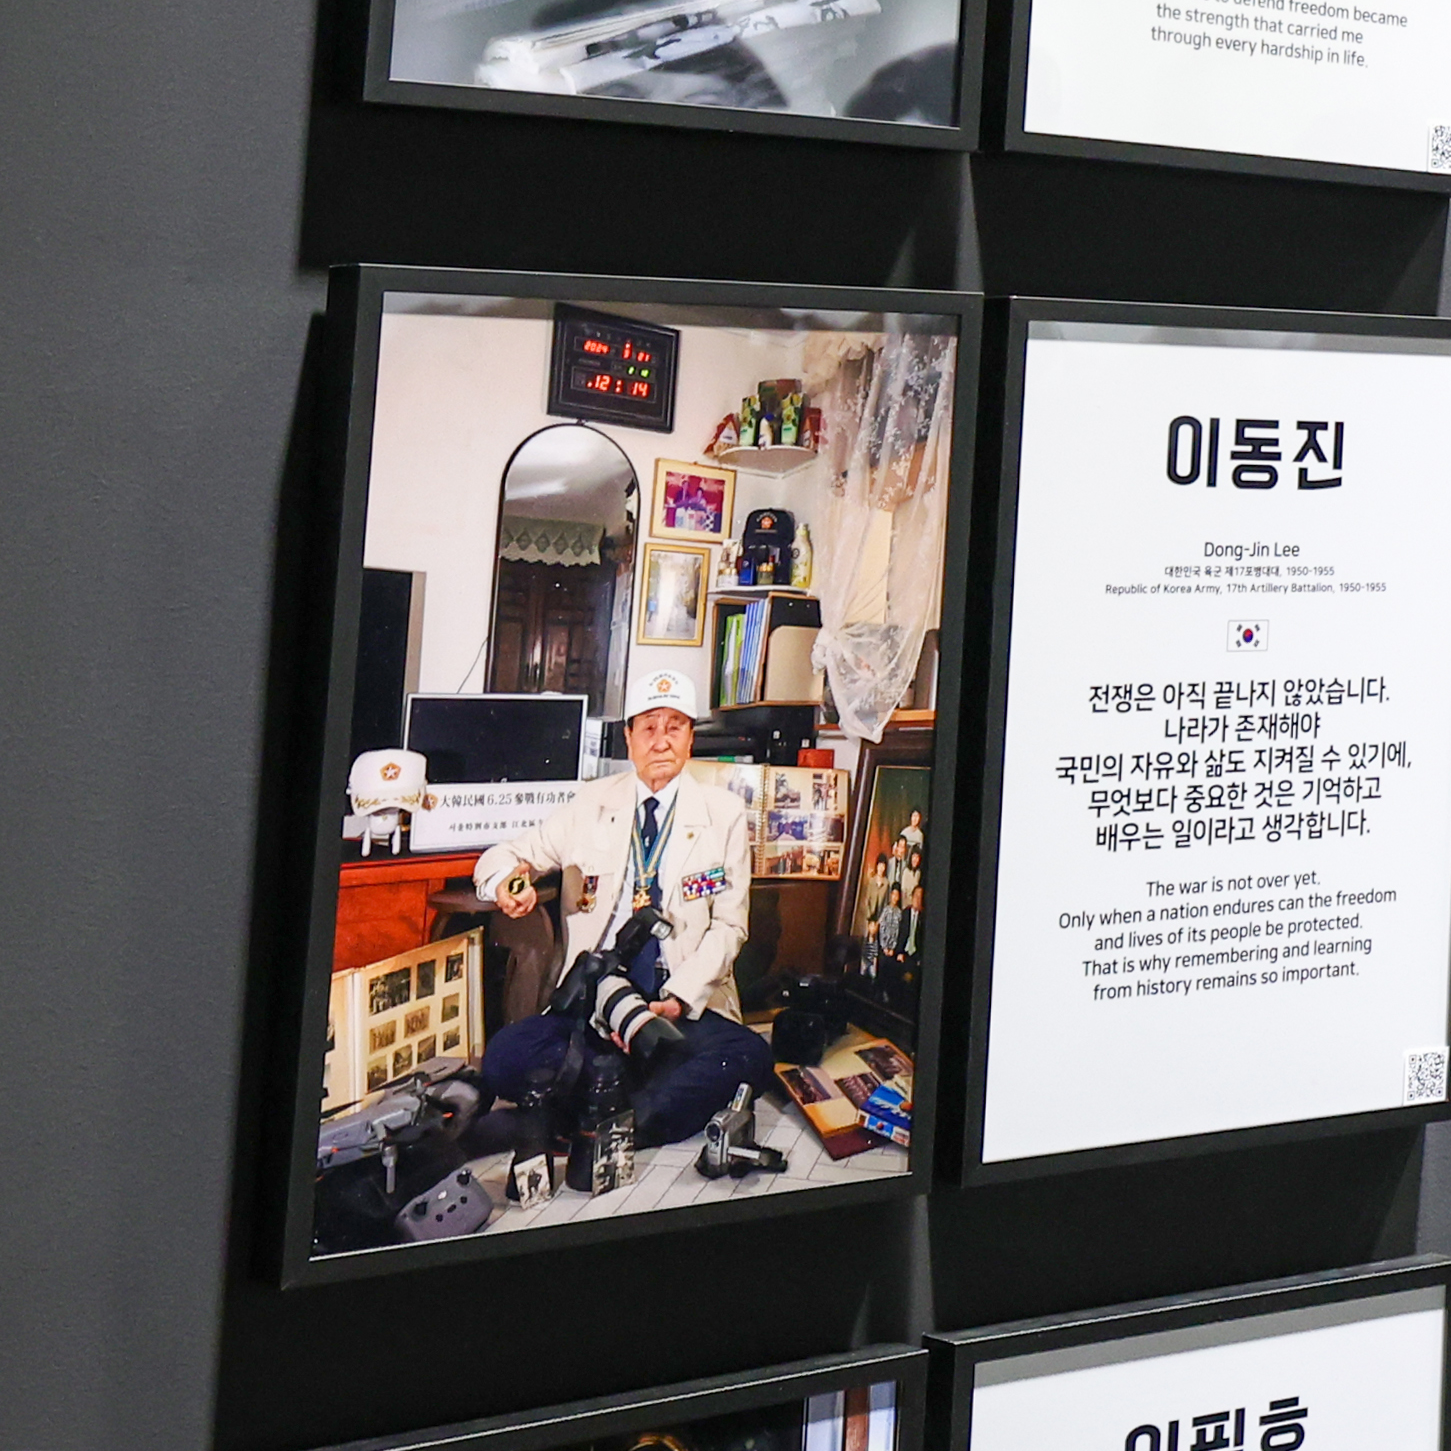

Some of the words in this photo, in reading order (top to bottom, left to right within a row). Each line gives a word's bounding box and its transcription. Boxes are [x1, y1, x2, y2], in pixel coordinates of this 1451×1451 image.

[1165, 414, 1345, 491] 이동진
[1203, 540, 1270, 562] Dong-Jin
[1273, 541, 1300, 558] Lee
[1164, 565, 1202, 578] 대한민국
[1285, 565, 1336, 577] 1950-1955
[1088, 682, 1156, 714] 전쟁은
[1162, 680, 1206, 711] 아직
[1212, 678, 1276, 710] 끝나지
[1282, 675, 1390, 707] 않았습니다.
[1164, 714, 1229, 745] 나라가
[1234, 711, 1321, 742] 존재해야
[1055, 753, 1123, 785] 국민의
[1129, 749, 1199, 781] 자유와
[1203, 748, 1247, 778] 삶도
[1252, 744, 1314, 775] 지켜질
[1320, 744, 1341, 772] 수
[1347, 740, 1411, 770] 있기에,
[1087, 785, 1178, 818] 무엇보다
[1183, 781, 1248, 814] 중요한
[1253, 779, 1295, 809] 것은
[1302, 775, 1382, 806] 기억하고
[1095, 821, 1165, 852] 배우는
[1171, 816, 1256, 849] 일이라고
[1261, 808, 1370, 843] 생각합니다.
[1145, 880, 1175, 897] The
[1178, 880, 1208, 895] war
[1211, 875, 1224, 893] is
[1227, 874, 1253, 891] not
[1256, 874, 1290, 889] over
[1293, 870, 1320, 890] yet.
[1058, 910, 1096, 931] Only
[1098, 908, 1142, 926] when
[1145, 908, 1156, 922] a
[1159, 902, 1209, 921] nation
[1212, 898, 1275, 917] endures
[1277, 896, 1304, 911] can
[1307, 892, 1332, 909] the
[1335, 888, 1397, 906] freedom
[1093, 932, 1124, 951] and
[1128, 930, 1163, 948] lives
[1166, 926, 1184, 945] of
[1187, 926, 1207, 943] its
[1209, 921, 1262, 945] people
[1264, 920, 1284, 936] be
[1287, 912, 1363, 938] protected.
[1081, 958, 1118, 977] That
[1122, 956, 1135, 973] is
[1138, 953, 1172, 974] why
[1174, 944, 1279, 968] remembering
[1281, 940, 1310, 959] and
[1313, 936, 1372, 955] learning
[1093, 983, 1132, 1001] from
[1136, 978, 1192, 997] history
[1195, 970, 1257, 991] remains
[1260, 970, 1278, 985] so
[1281, 961, 1359, 984] important.
